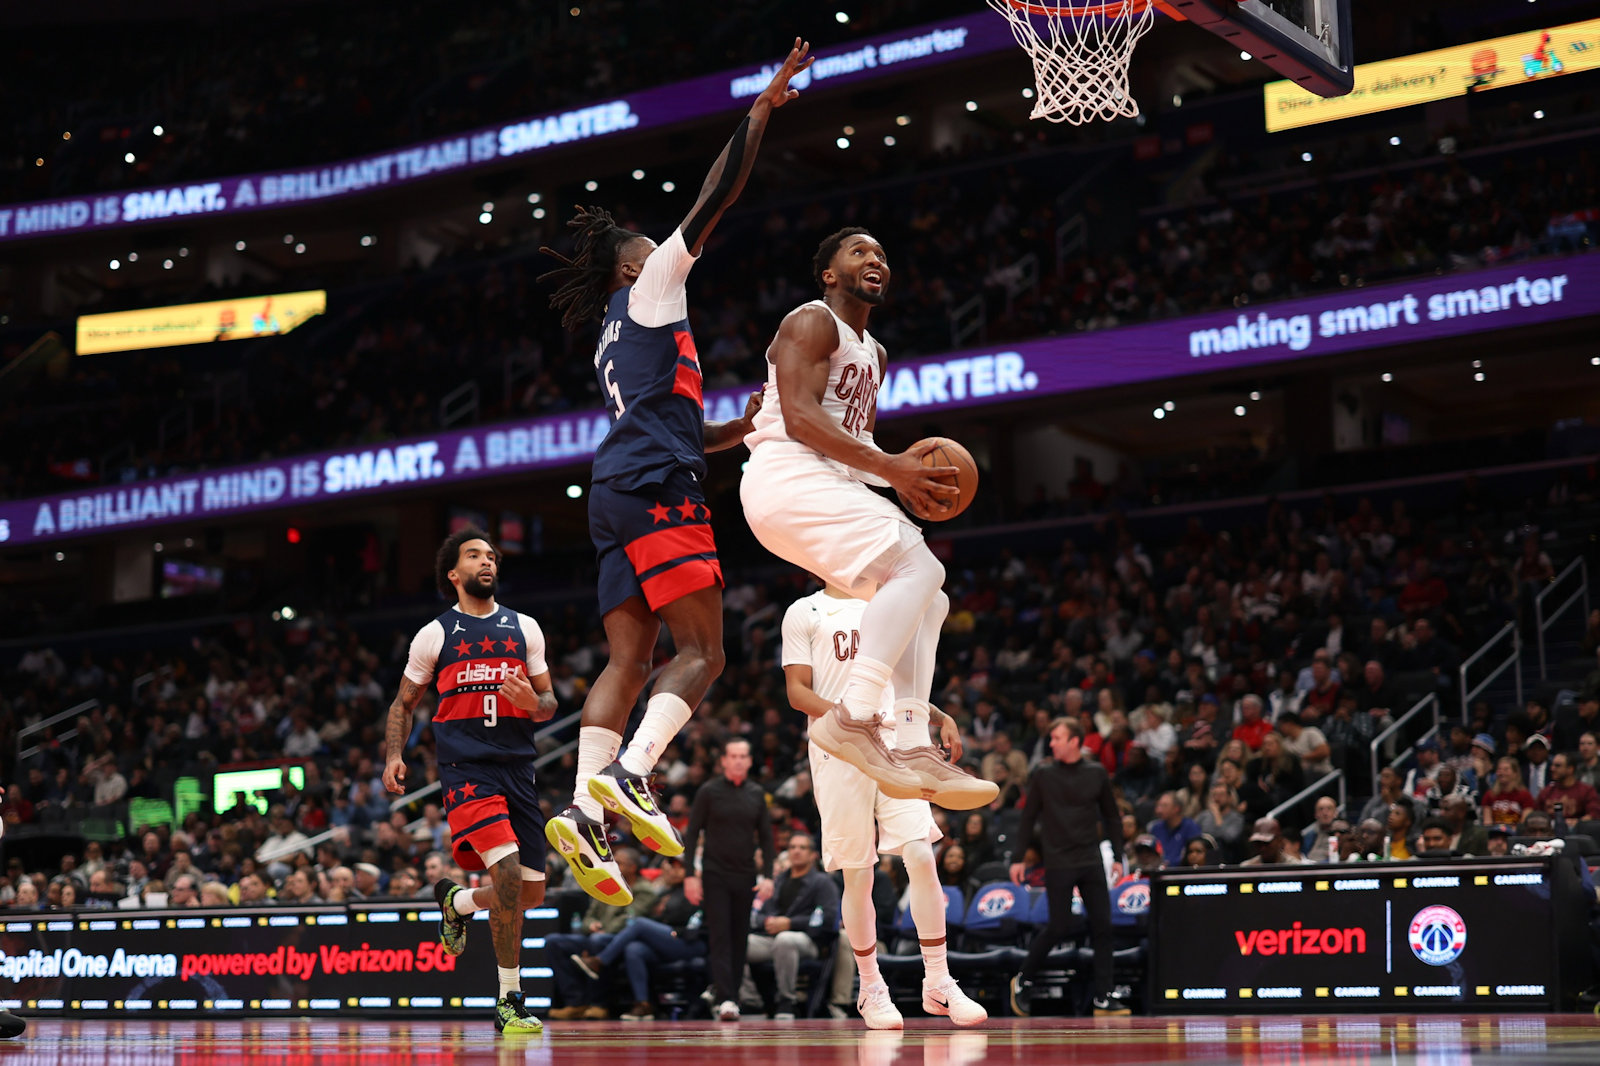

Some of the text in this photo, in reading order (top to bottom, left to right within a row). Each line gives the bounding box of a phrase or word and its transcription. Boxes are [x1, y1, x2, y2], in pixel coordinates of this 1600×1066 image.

[731, 27, 968, 98] makg smart smarter
[15, 201, 90, 235] MIND
[94, 196, 119, 225] IS
[122, 182, 227, 222] SMART.
[233, 178, 257, 208] A
[260, 155, 394, 202] BRILLIANT
[396, 138, 468, 180] TEAM
[470, 131, 498, 163] IS
[499, 100, 640, 156] SMARTER.
[1189, 273, 1568, 358] making smart smarter
[33, 502, 56, 537] A
[58, 479, 201, 533] BRILLIANT
[202, 466, 287, 511] MIND
[290, 460, 320, 499] IS
[323, 441, 446, 494] SMART.
[453, 436, 482, 474] A
[483, 694, 498, 728] 9
[62, 948, 108, 977] One
[108, 948, 177, 977] Arena
[181, 945, 284, 981] powered
[286, 945, 317, 980] by
[319, 943, 413, 975] Verizon
[415, 941, 457, 973] 5G
[1234, 921, 1366, 956] verizon
